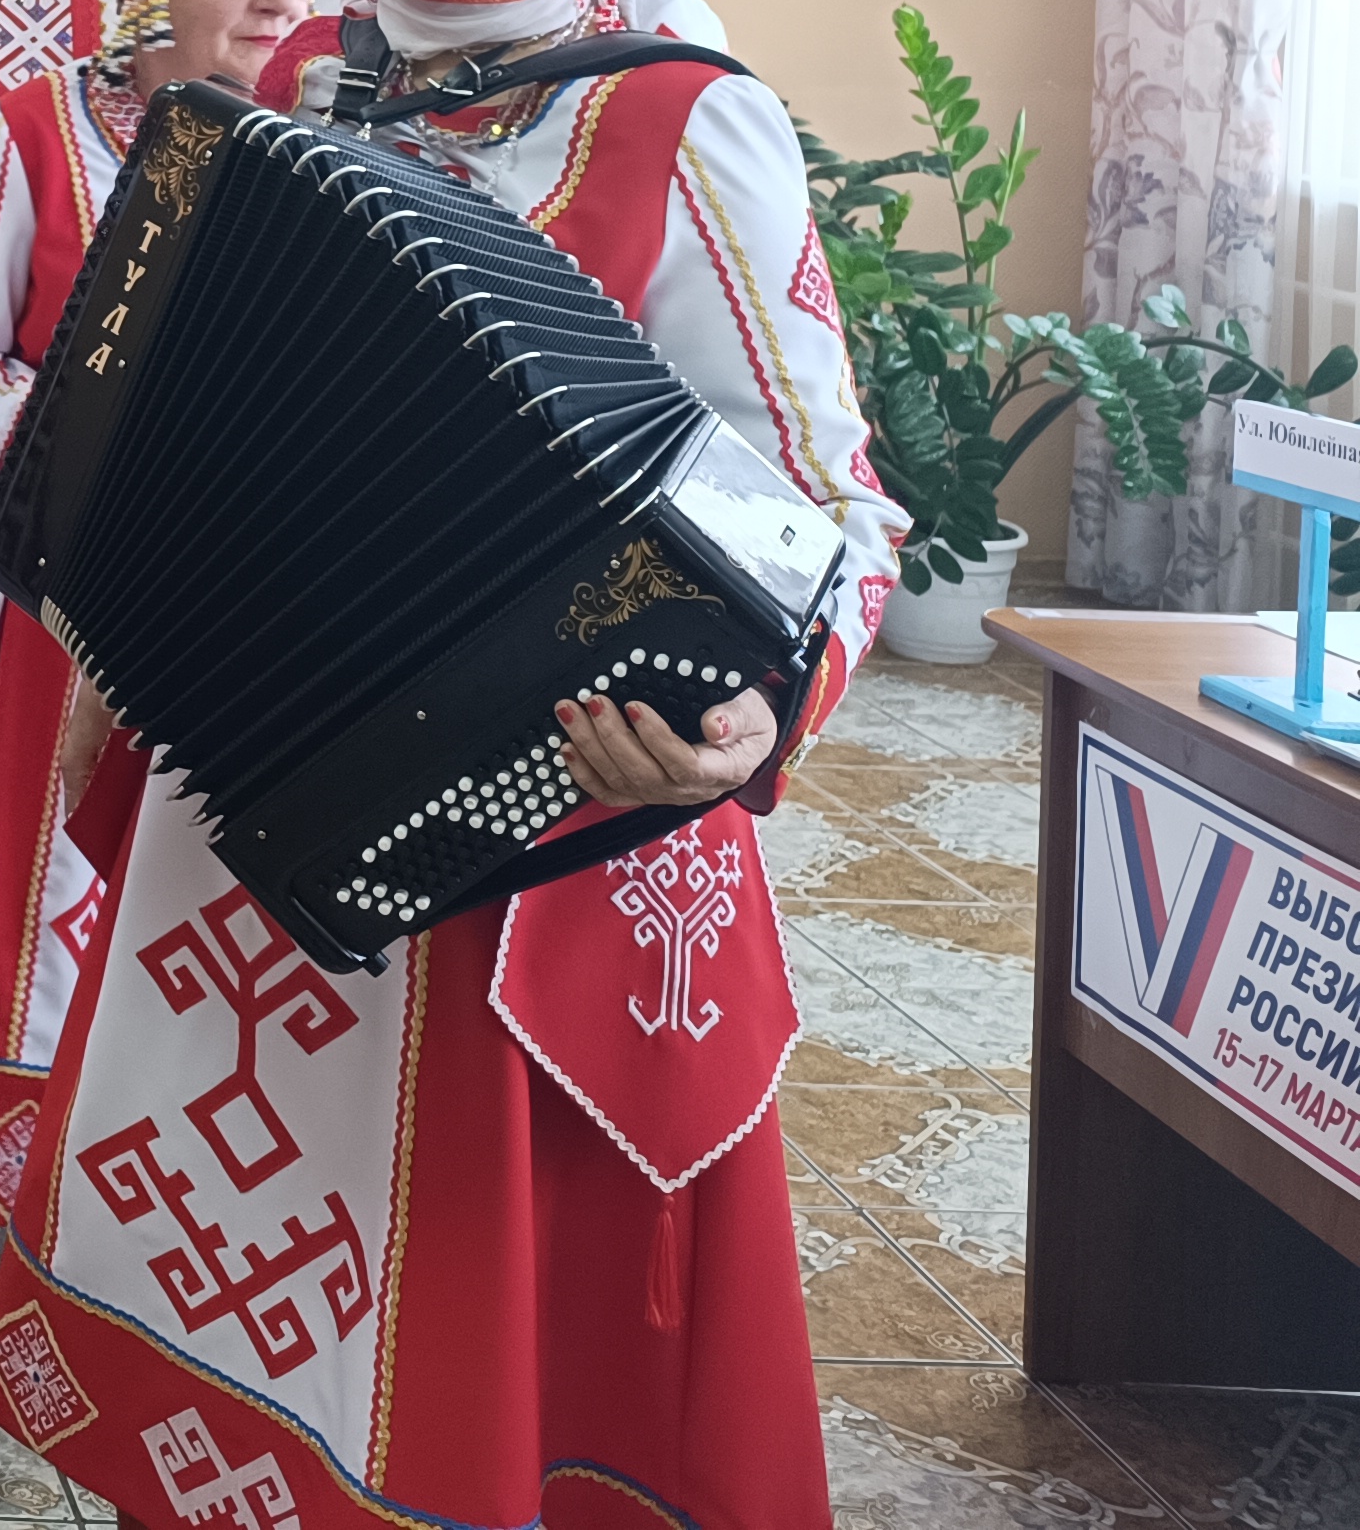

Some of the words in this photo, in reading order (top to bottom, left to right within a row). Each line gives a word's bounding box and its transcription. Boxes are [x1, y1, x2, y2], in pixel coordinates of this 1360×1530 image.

[85, 220, 162, 375] ТУЛА
[1238, 413, 1263, 438] Ул.
[1268, 421, 1360, 464] Юбилейна
[1246, 920, 1360, 1034] ПРЕЗИ
